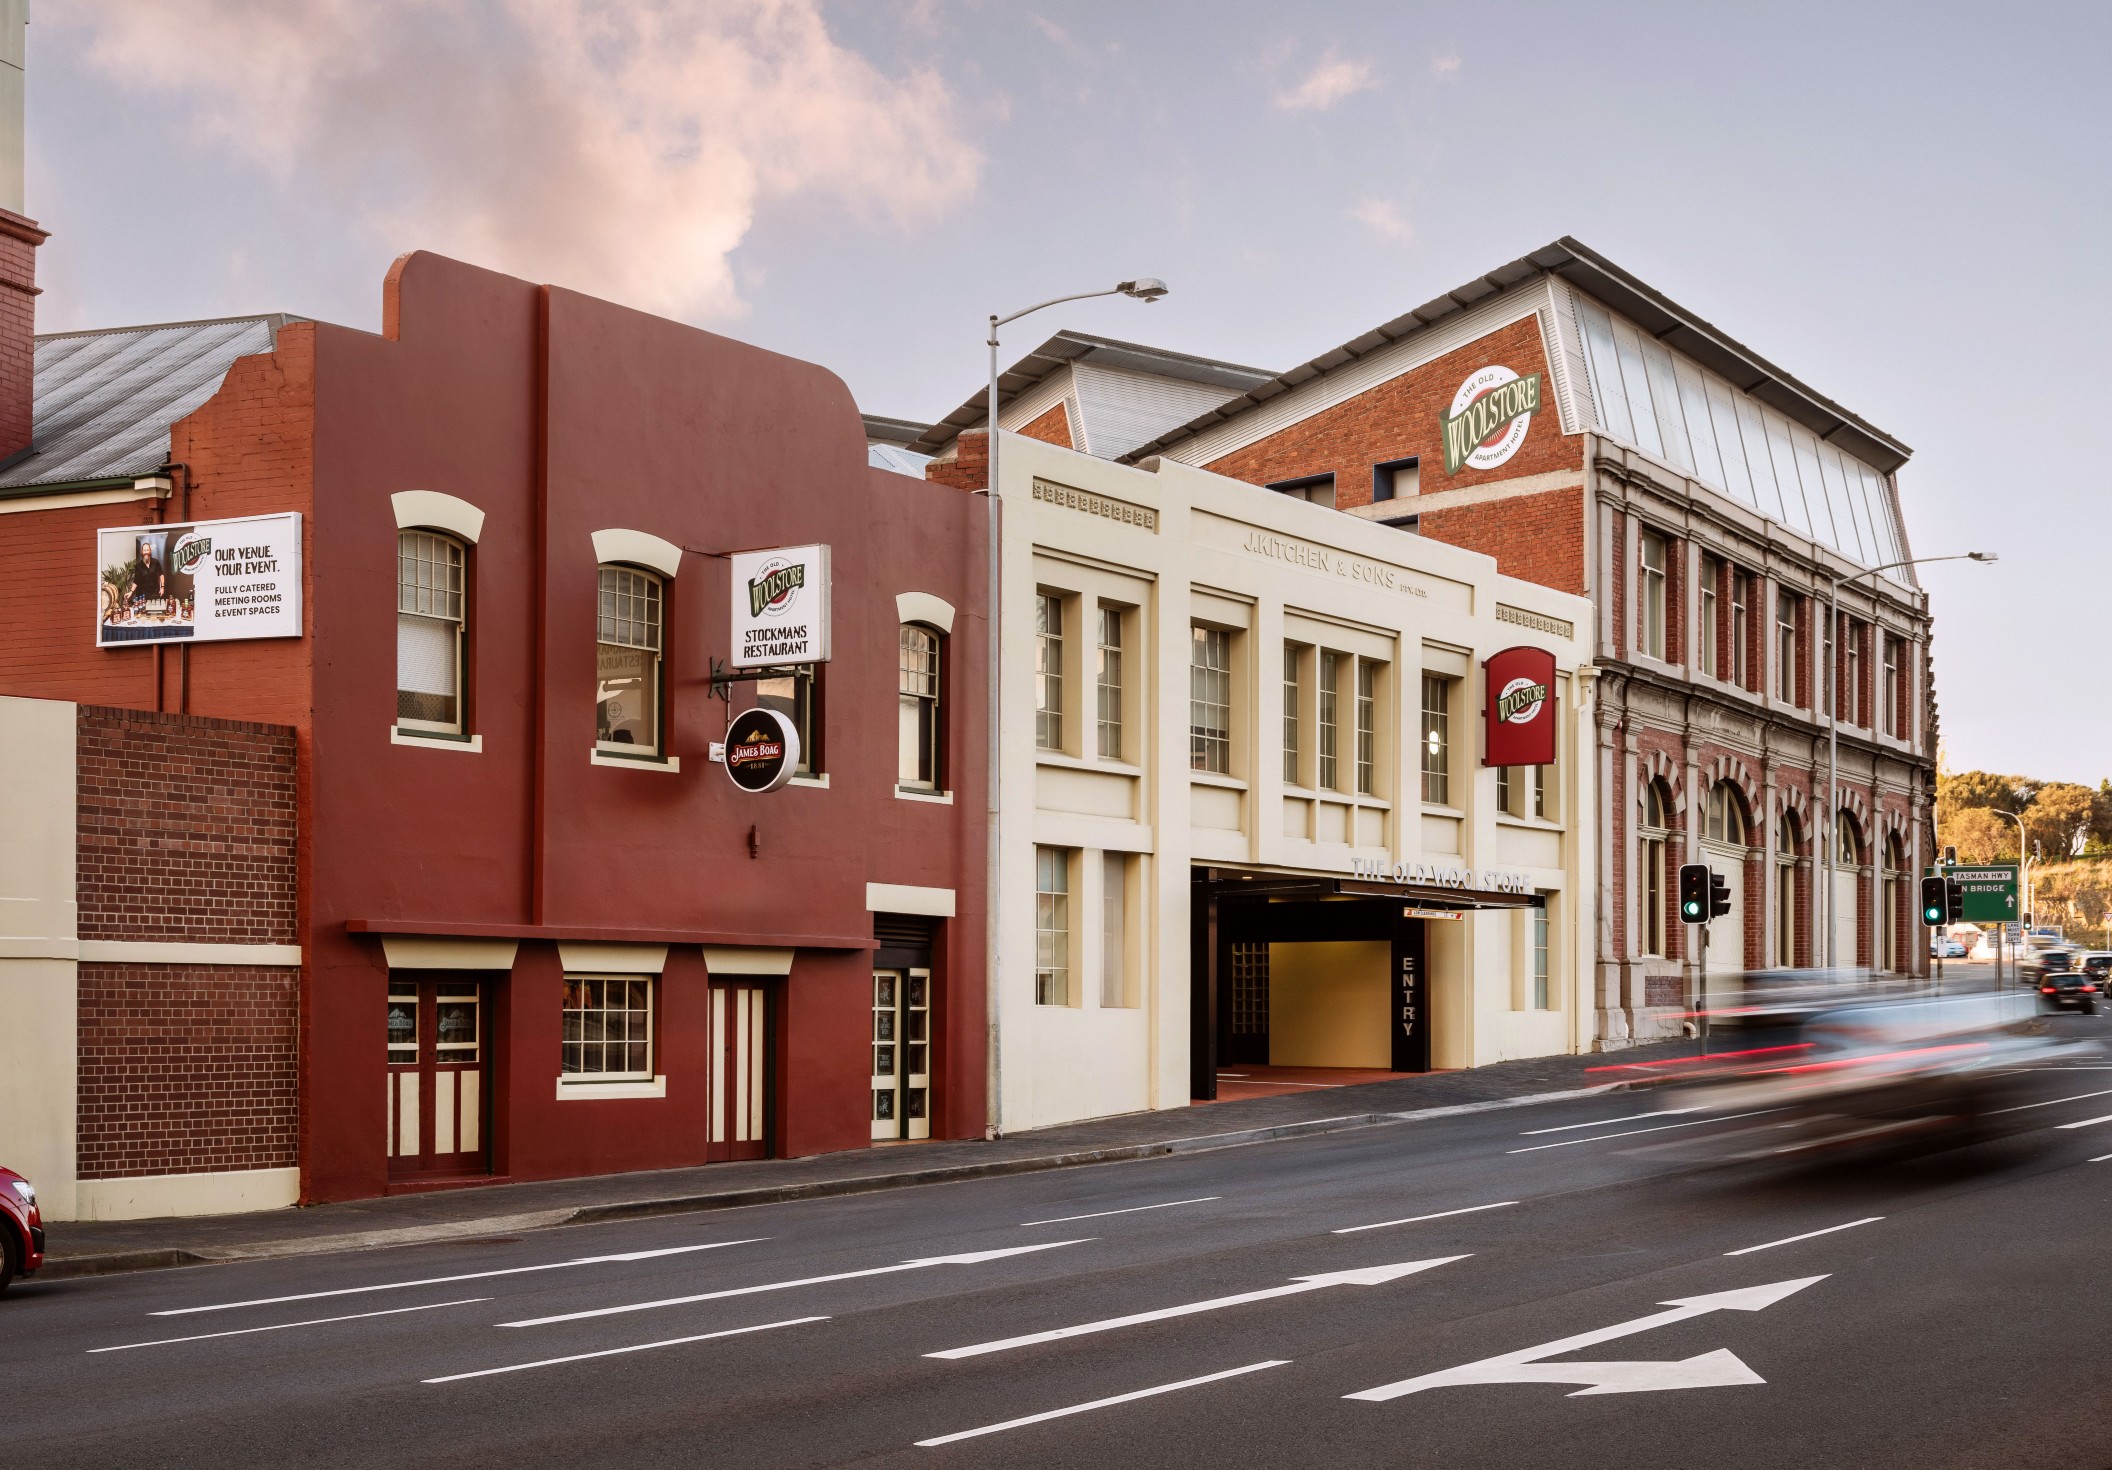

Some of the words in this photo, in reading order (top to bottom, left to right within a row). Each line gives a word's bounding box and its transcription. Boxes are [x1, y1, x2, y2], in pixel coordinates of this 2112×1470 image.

[1462, 382, 1476, 398] THE
[1478, 373, 1494, 385] OLD
[1448, 377, 1536, 470] WOOLSTORE
[1475, 444, 1511, 462] APARTMENT
[1511, 419, 1524, 444] HOTEL
[172, 540, 210, 573] WOOLSTORE
[214, 547, 235, 562] OUR
[238, 545, 274, 560] VENUE.
[214, 562, 243, 576] YOUR
[245, 560, 280, 575] EVENT.
[1336, 559, 1346, 577] &
[1352, 563, 1396, 589] SONS
[214, 586, 238, 594] FULLY
[239, 582, 276, 592] CATERED
[214, 596, 250, 606] MEETING
[252, 594, 282, 604] ROOMS
[753, 566, 802, 614] WOOLSTORE
[214, 610, 222, 618] &
[222, 607, 247, 616] EVENT
[248, 606, 280, 615] SPACES
[745, 625, 807, 643] STOCKMANS
[743, 640, 809, 659] RESTAURANT
[1499, 685, 1545, 722] WOOLSTORE
[732, 747, 758, 762] JAMES
[760, 744, 779, 756] BOAG
[1351, 857, 1385, 882] THE
[1392, 862, 1426, 886] OLD
[1402, 957, 1416, 1036] ENTRY
